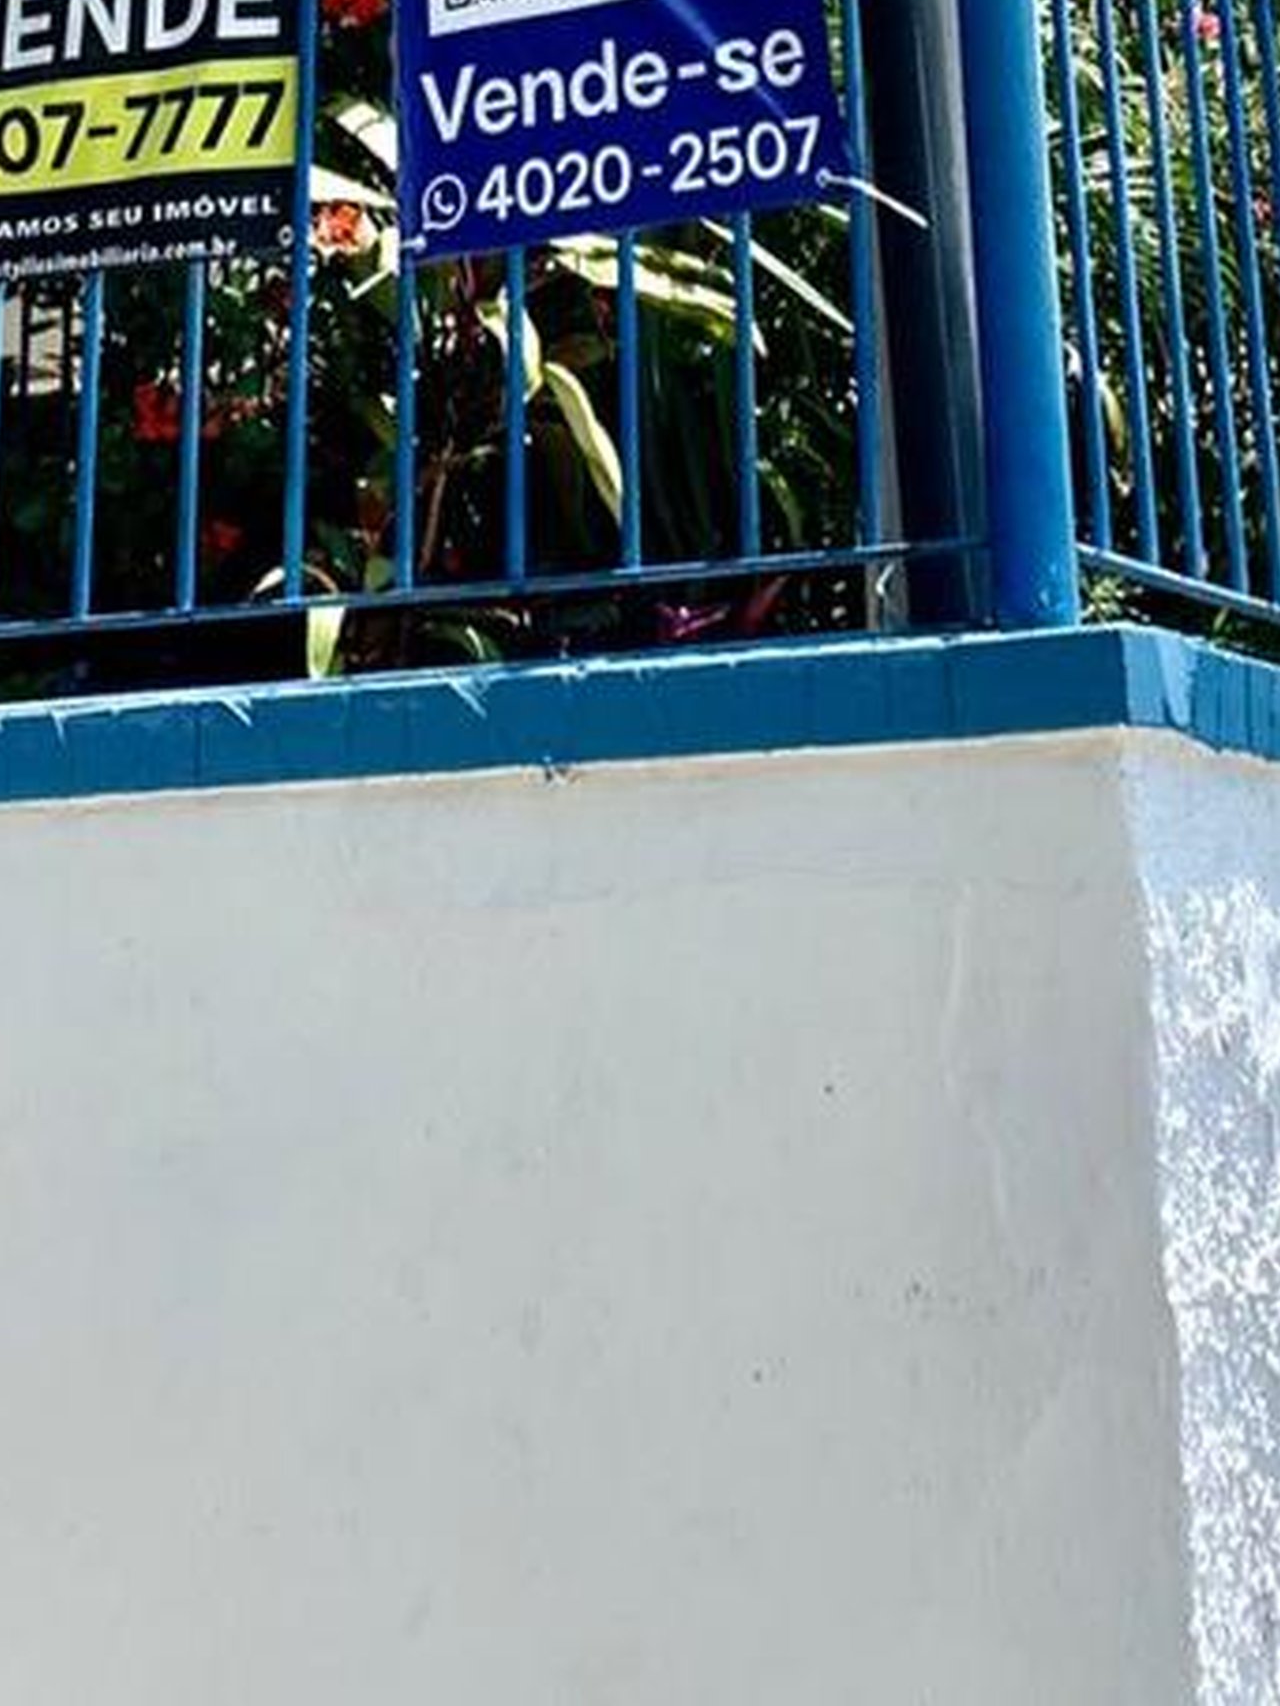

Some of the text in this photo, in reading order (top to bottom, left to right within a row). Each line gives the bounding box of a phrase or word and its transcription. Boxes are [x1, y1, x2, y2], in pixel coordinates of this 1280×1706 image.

[422, 28, 806, 144] Vende-se
[88, 204, 143, 230] SEU
[153, 193, 280, 222] IMÓVEL
